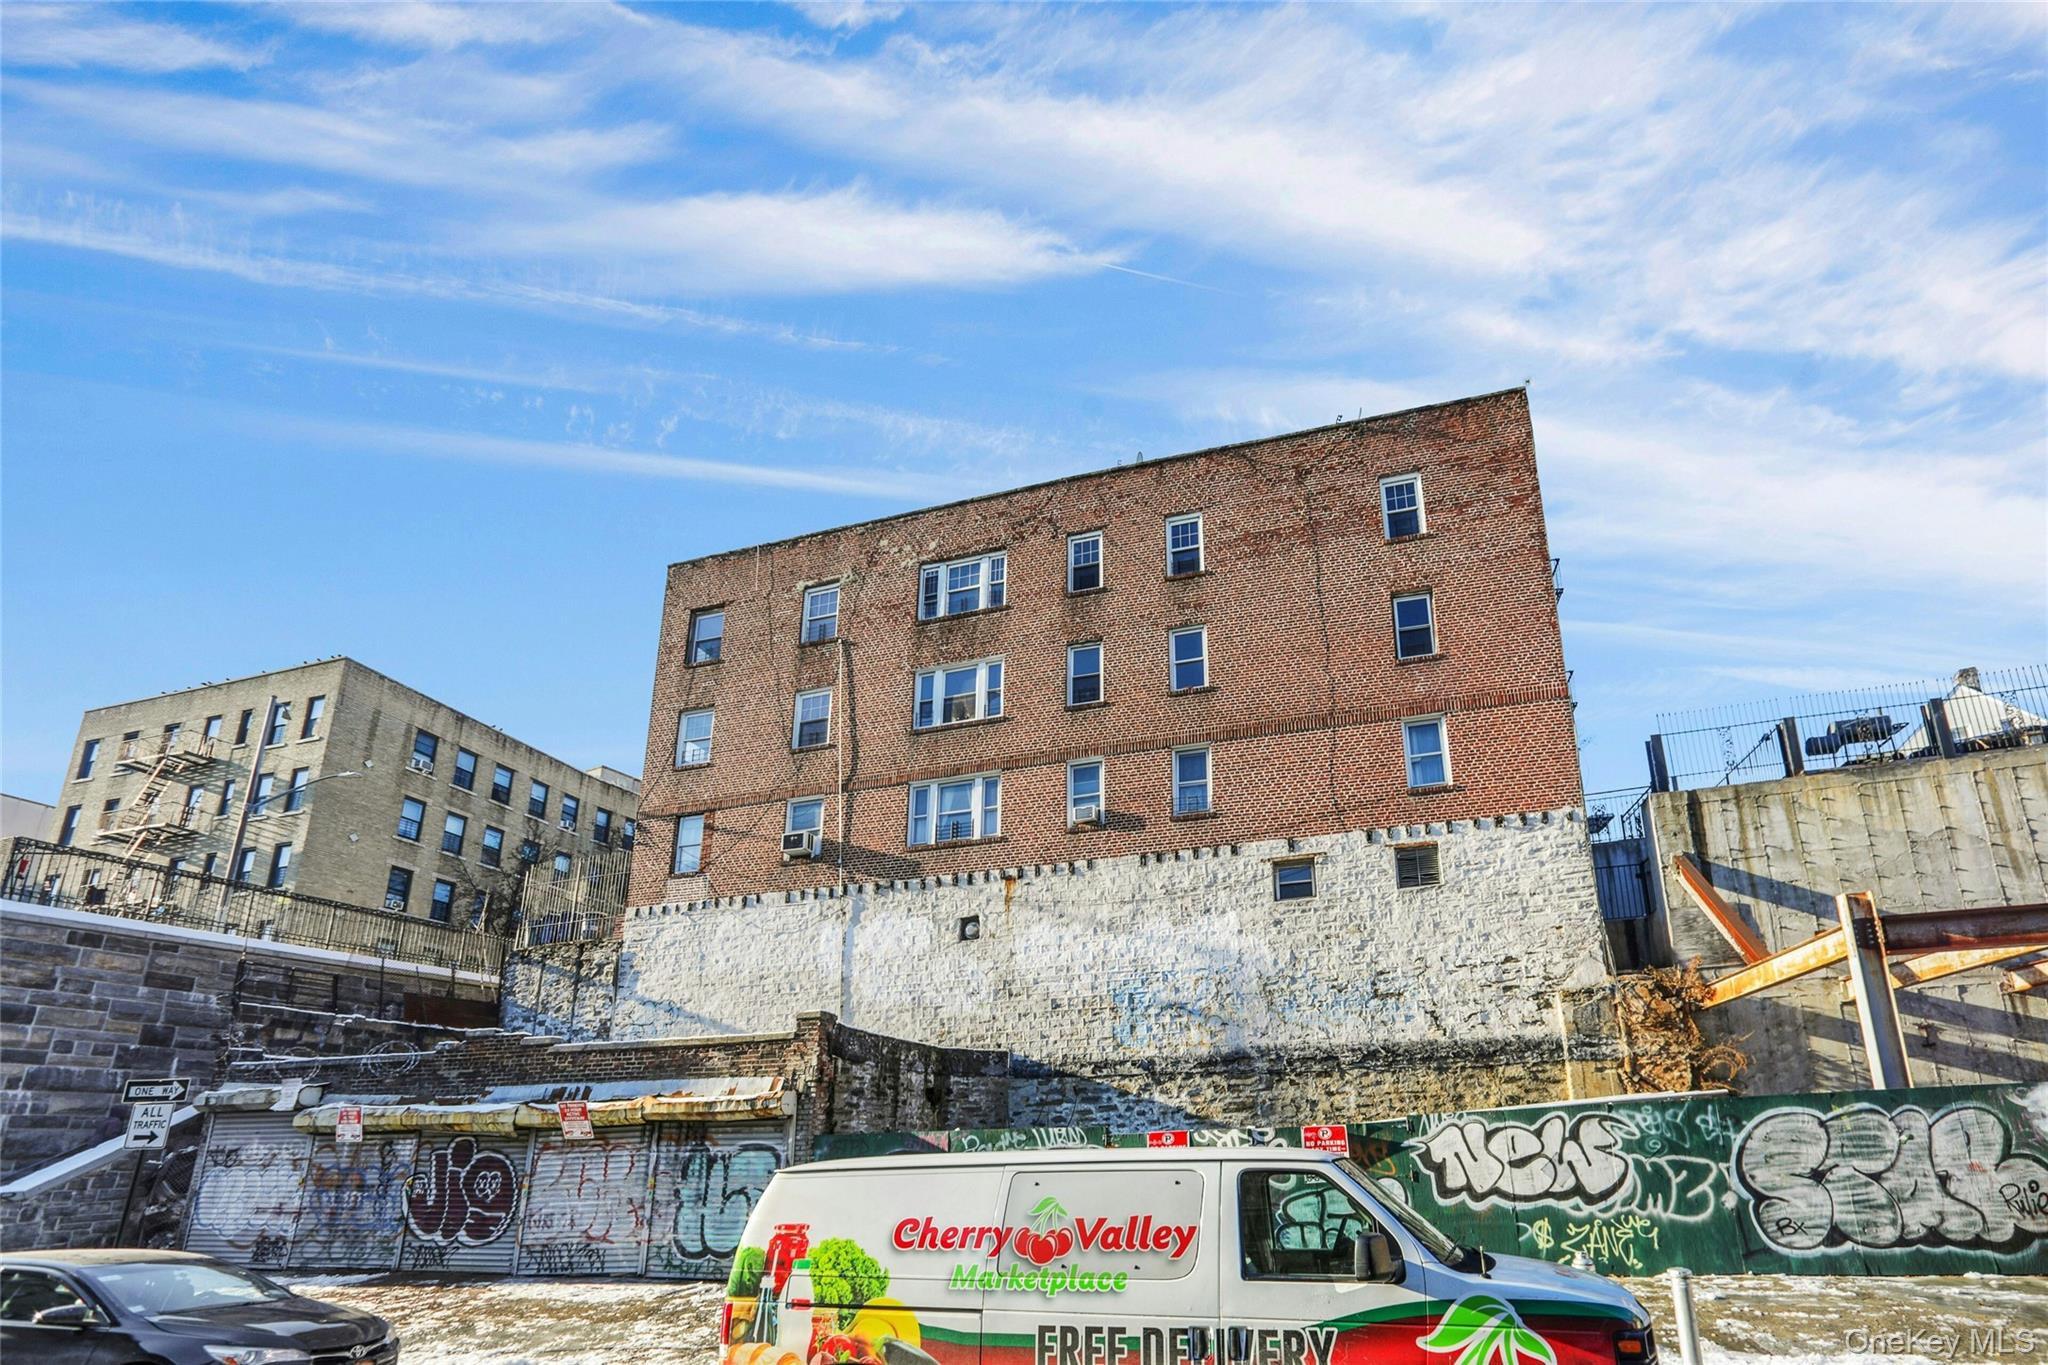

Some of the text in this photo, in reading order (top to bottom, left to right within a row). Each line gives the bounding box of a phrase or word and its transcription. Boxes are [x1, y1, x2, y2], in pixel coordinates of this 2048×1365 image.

[134, 1086, 180, 1096] ONE WAY
[141, 1106, 163, 1118] ALL
[133, 1120, 167, 1130] TRAFFIC
[892, 1214, 1199, 1260] Cherry Valley
[949, 1263, 1130, 1298] Marketplace
[1037, 1325, 1336, 1365] FREE DEIERY
